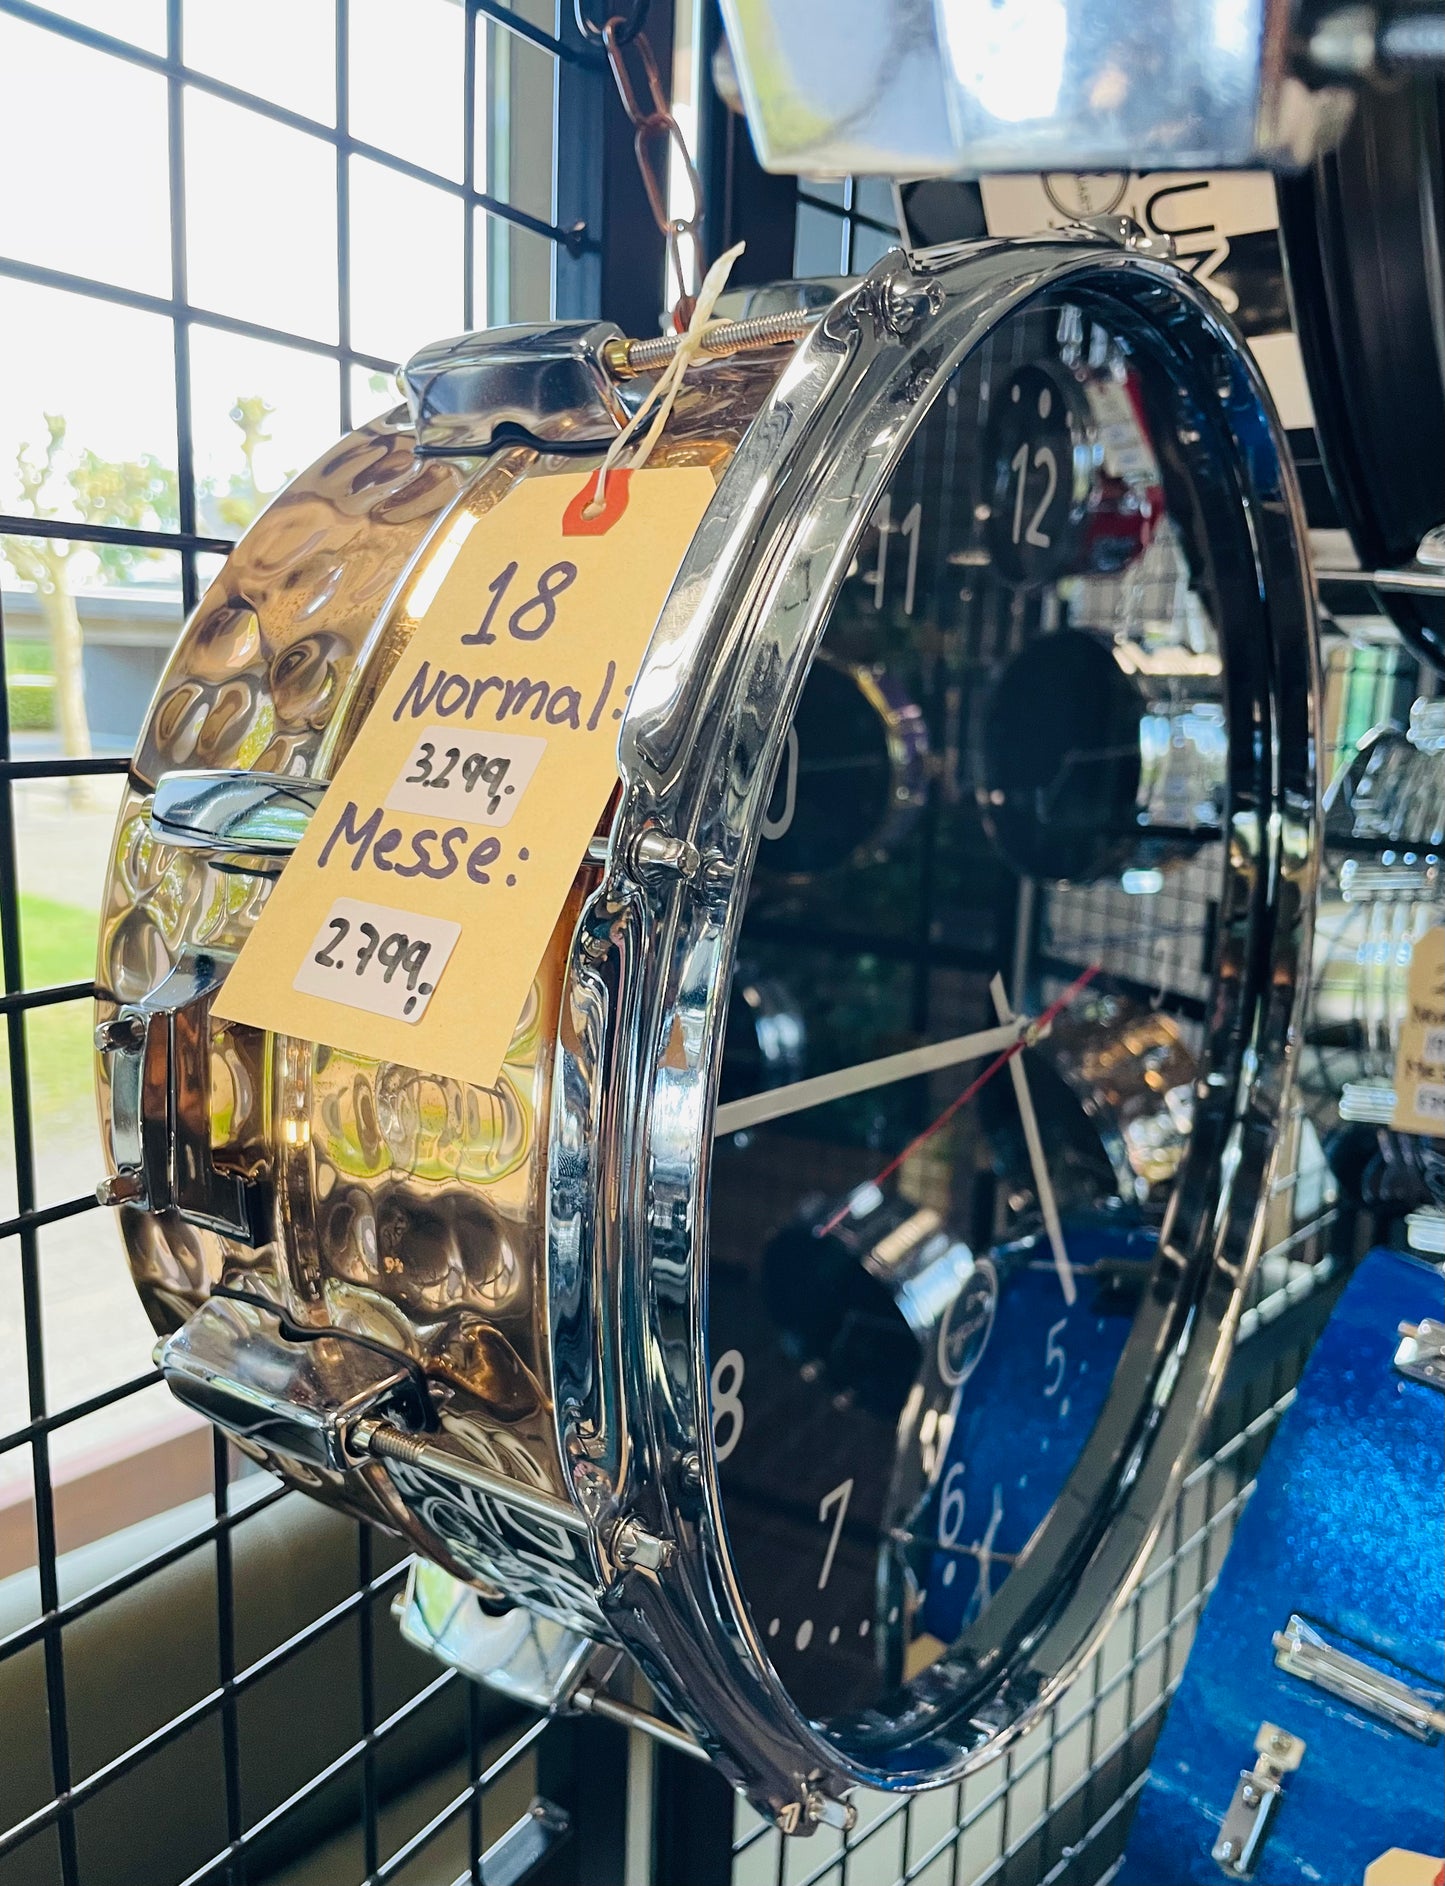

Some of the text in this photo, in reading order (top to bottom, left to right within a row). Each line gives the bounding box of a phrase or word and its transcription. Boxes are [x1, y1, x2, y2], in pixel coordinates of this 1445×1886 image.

[1140, 172, 1239, 314] UM
[1012, 443, 1058, 548] 12
[460, 561, 578, 646] 18
[869, 493, 922, 615] 11
[392, 661, 632, 731] Normal:
[761, 720, 799, 840] 0
[317, 801, 530, 888] Messe:
[710, 1349, 745, 1462] 8
[1044, 1318, 1068, 1396] 5
[819, 1478, 854, 1589] 7
[938, 1462, 966, 1546] 6
